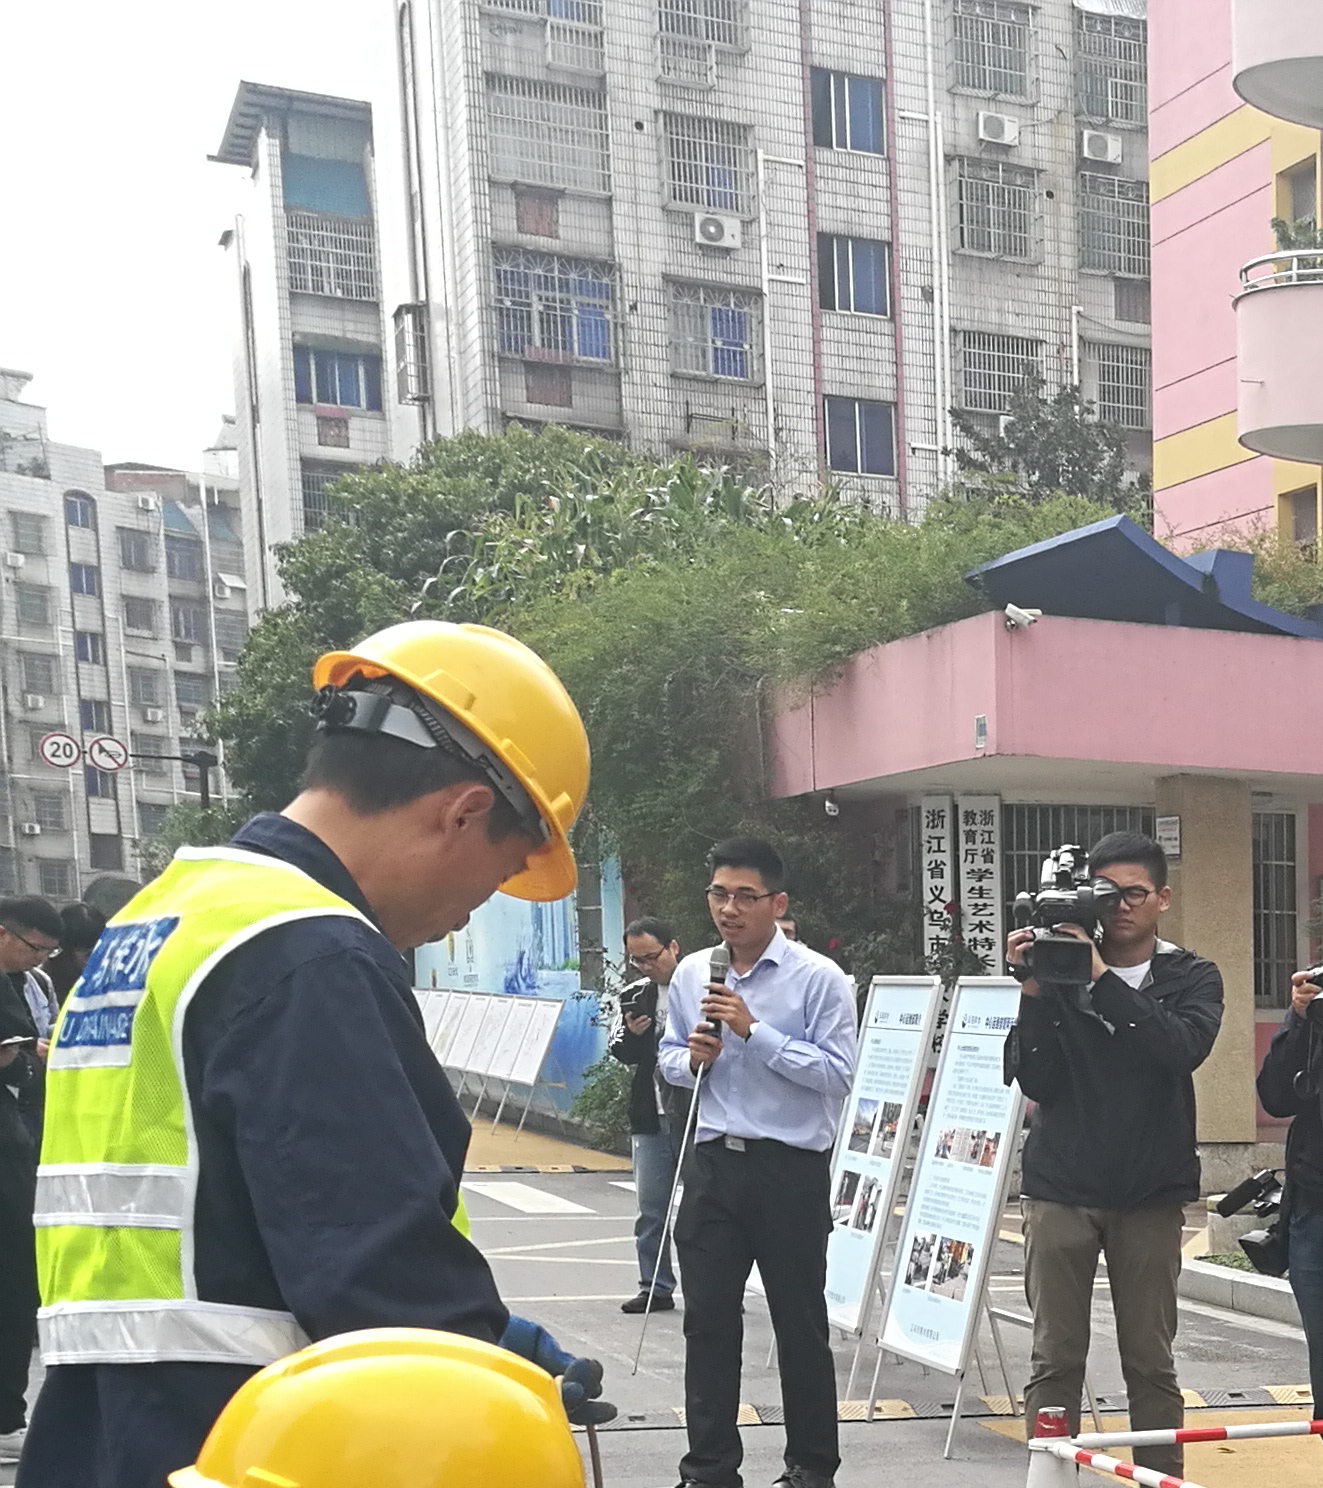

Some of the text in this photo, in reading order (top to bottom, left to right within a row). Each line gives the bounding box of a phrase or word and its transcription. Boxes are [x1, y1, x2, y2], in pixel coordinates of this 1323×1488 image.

[50, 741, 73, 759] 20
[963, 809, 978, 865] 教育厅
[979, 809, 995, 865] 浙江省
